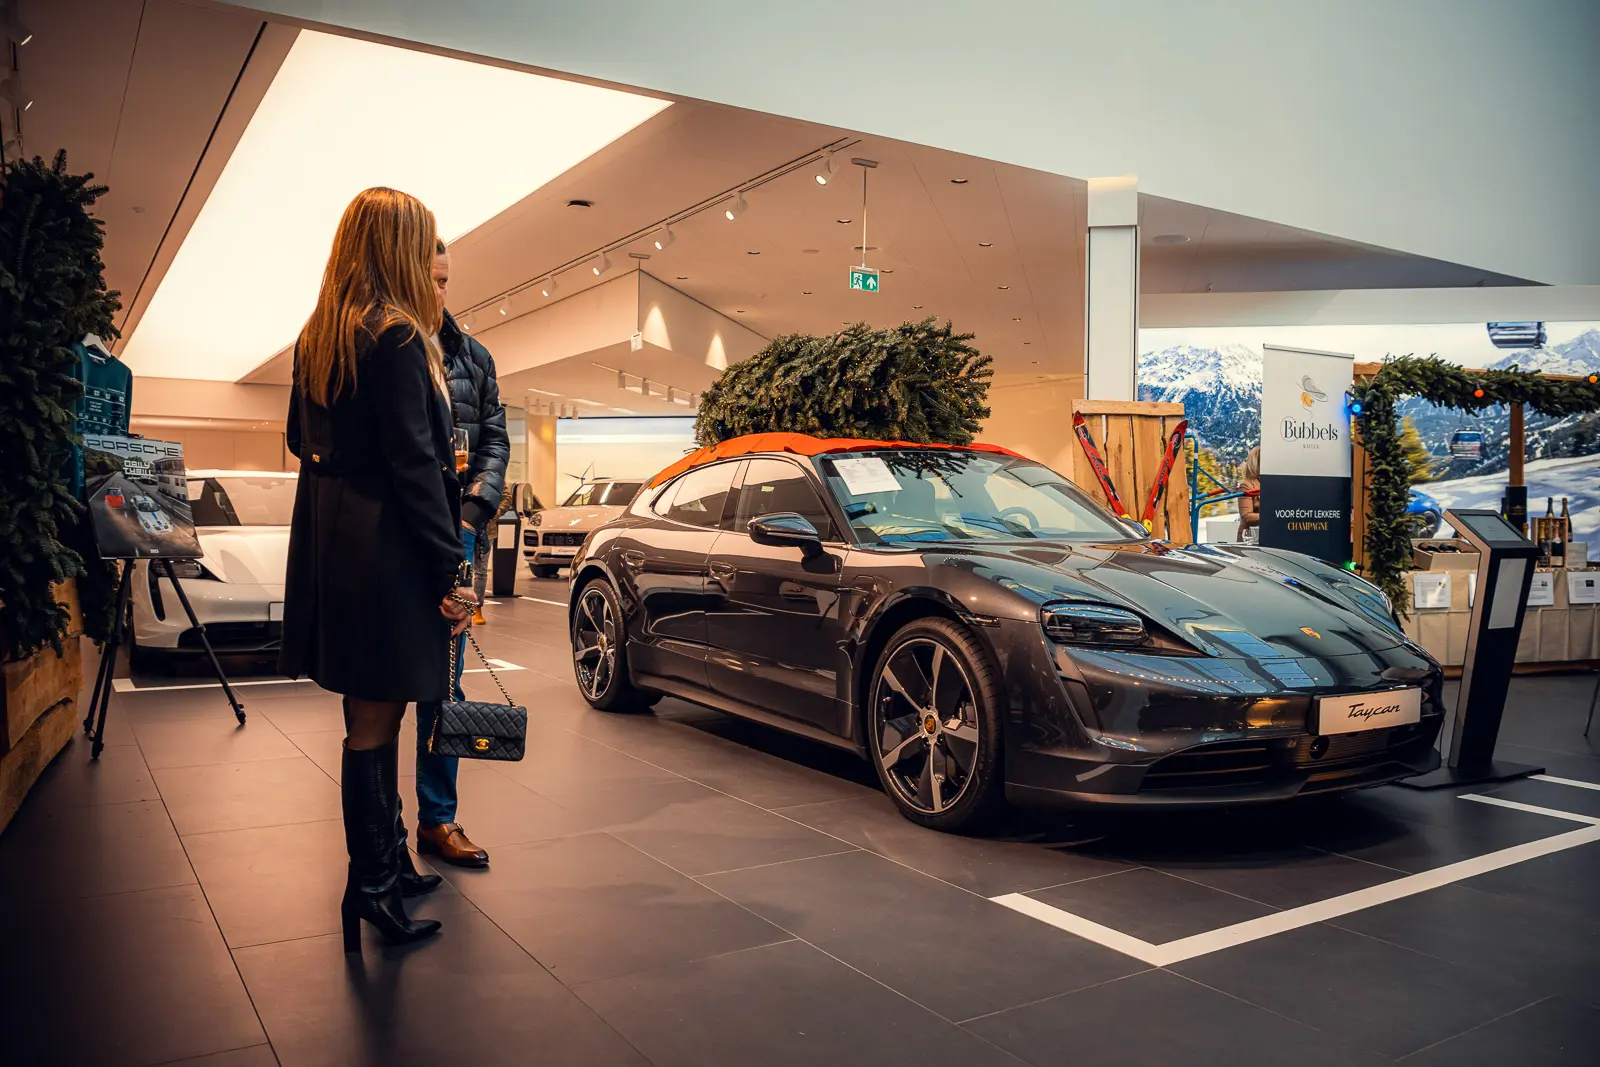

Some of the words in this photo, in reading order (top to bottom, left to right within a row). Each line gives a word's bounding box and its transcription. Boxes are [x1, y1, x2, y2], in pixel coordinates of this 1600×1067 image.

[86, 439, 179, 457] PORSCHE
[1275, 510, 1294, 518] VOOR
[1296, 508, 1313, 518] ÉCHT
[1314, 510, 1341, 518] LEKKERE
[1287, 521, 1328, 531] CHAMPAGNE
[1348, 702, 1400, 722] Taycan
